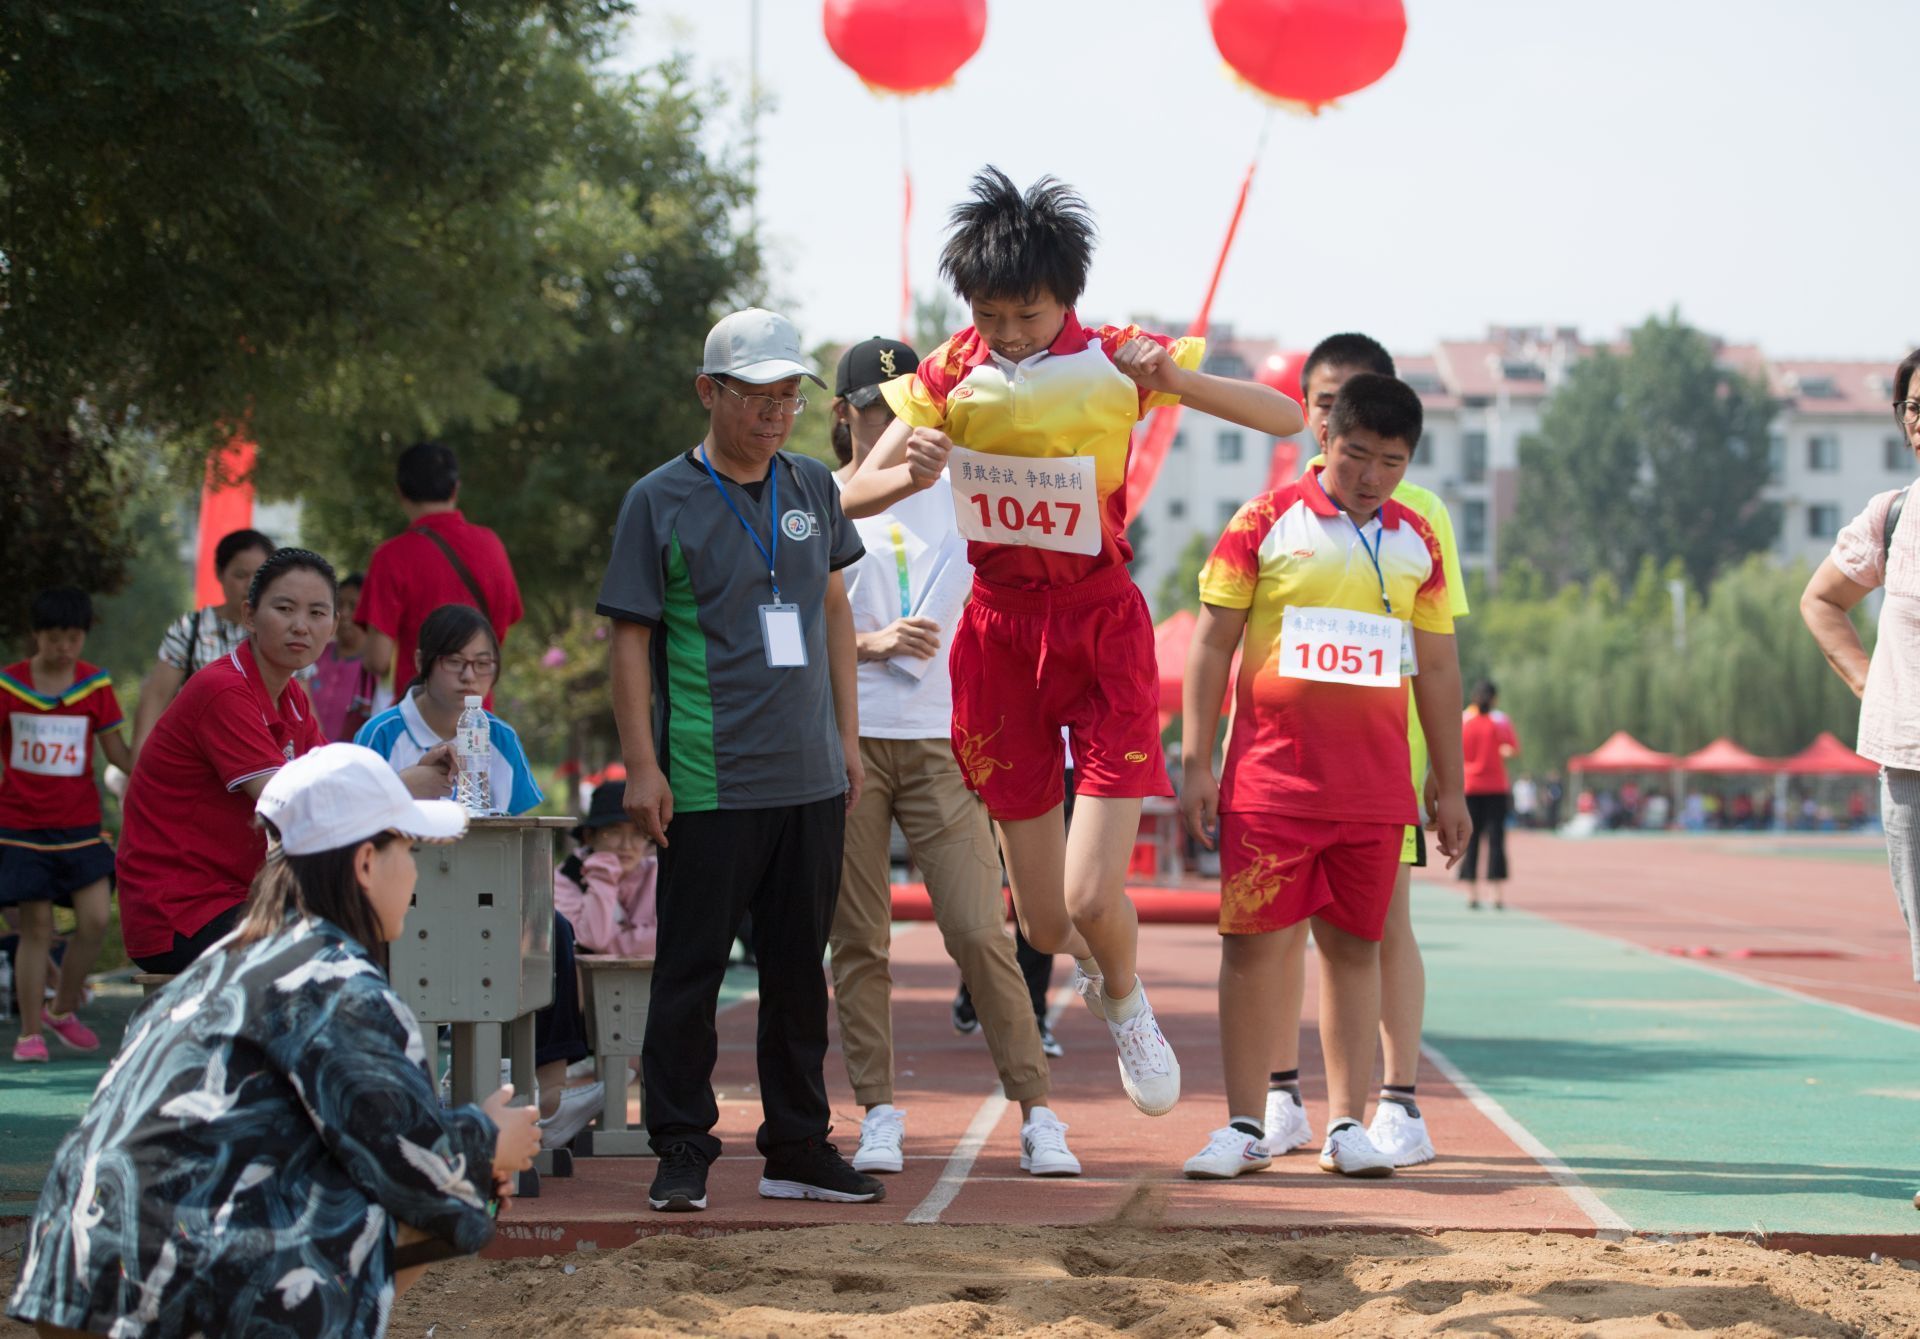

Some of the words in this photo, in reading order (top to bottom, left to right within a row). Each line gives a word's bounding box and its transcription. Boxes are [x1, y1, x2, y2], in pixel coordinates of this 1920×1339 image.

[961, 462, 1017, 485] 勇敢尝试
[1025, 468, 1083, 490] 争取胜利
[970, 492, 1082, 537] 1047
[1295, 642, 1384, 677] 1051
[21, 739, 77, 767] 1074
